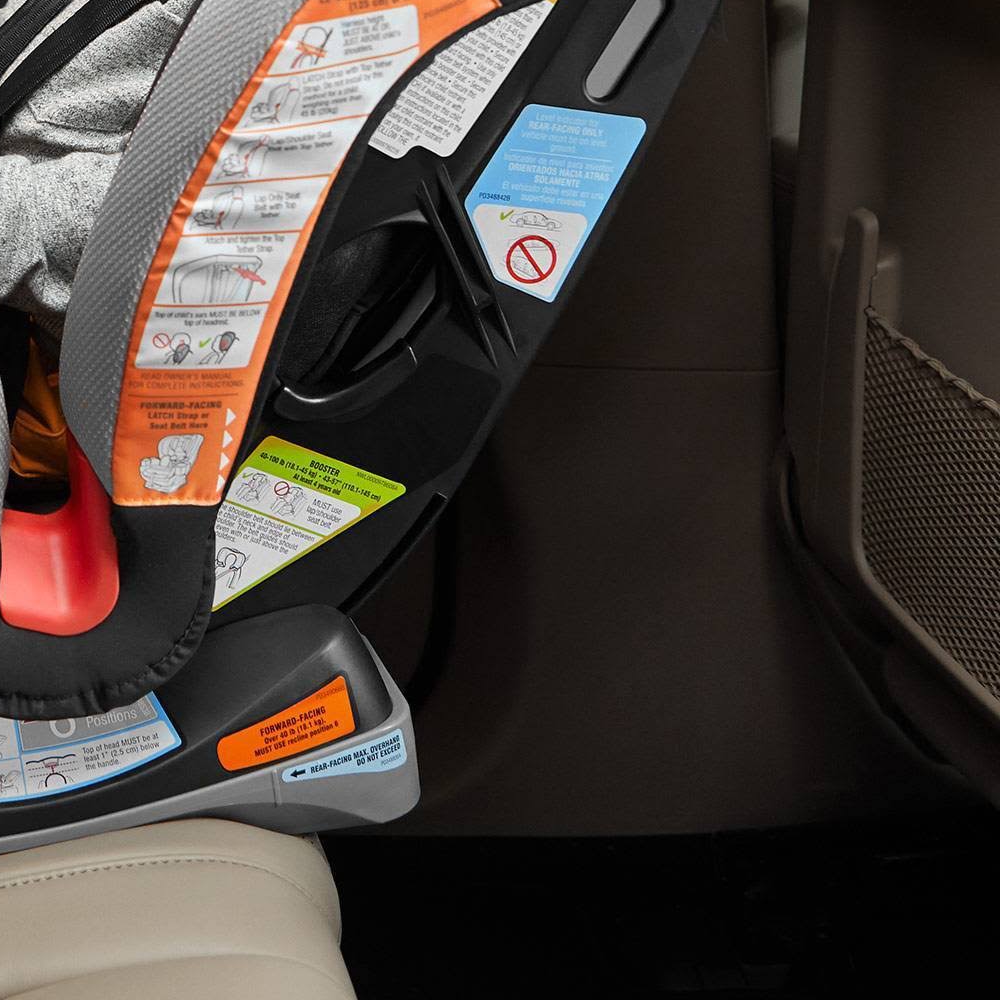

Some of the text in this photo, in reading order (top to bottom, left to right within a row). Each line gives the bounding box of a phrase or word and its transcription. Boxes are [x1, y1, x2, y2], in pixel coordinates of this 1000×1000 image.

[529, 121, 604, 137] REAR-FACING ONLY
[509, 163, 557, 176] ORIENTADOS
[560, 168, 583, 179] HACIA
[534, 175, 581, 188] SOLAMENTE
[259, 452, 280, 465] 40-100
[285, 461, 308, 475] (18.1-45
[308, 469, 317, 478] kg)
[369, 492, 381, 502] cm)
[309, 460, 341, 477] BOOSTER
[293, 473, 300, 481] At
[300, 476, 313, 486] least
[317, 483, 332, 493] years
[313, 499, 330, 510] MUST
[228, 506, 252, 518] shoulder
[264, 520, 284, 530] should
[291, 529, 314, 541] between
[307, 516, 319, 524] seat
[86, 708, 138, 728] Positions
[260, 706, 326, 736] FORWARD-FACING
[254, 746, 272, 757] MUST
[274, 740, 286, 750] USE
[288, 734, 308, 745] recline
[310, 723, 333, 737] position
[264, 734, 279, 744] Over
[297, 722, 313, 733] (18.1
[82, 746, 94, 755] Top
[104, 741, 119, 750] head
[121, 736, 141, 746] MUST
[84, 753, 99, 762] least
[111, 749, 123, 758] (2.5
[125, 746, 139, 754] cm)
[140, 742, 159, 751] below
[310, 754, 352, 774] REAR-FACING
[353, 749, 369, 760] MAX.
[370, 735, 400, 752] OVERHANG
[357, 758, 365, 766] DO
[366, 752, 379, 763] NOT
[380, 743, 400, 758] EXCEED
